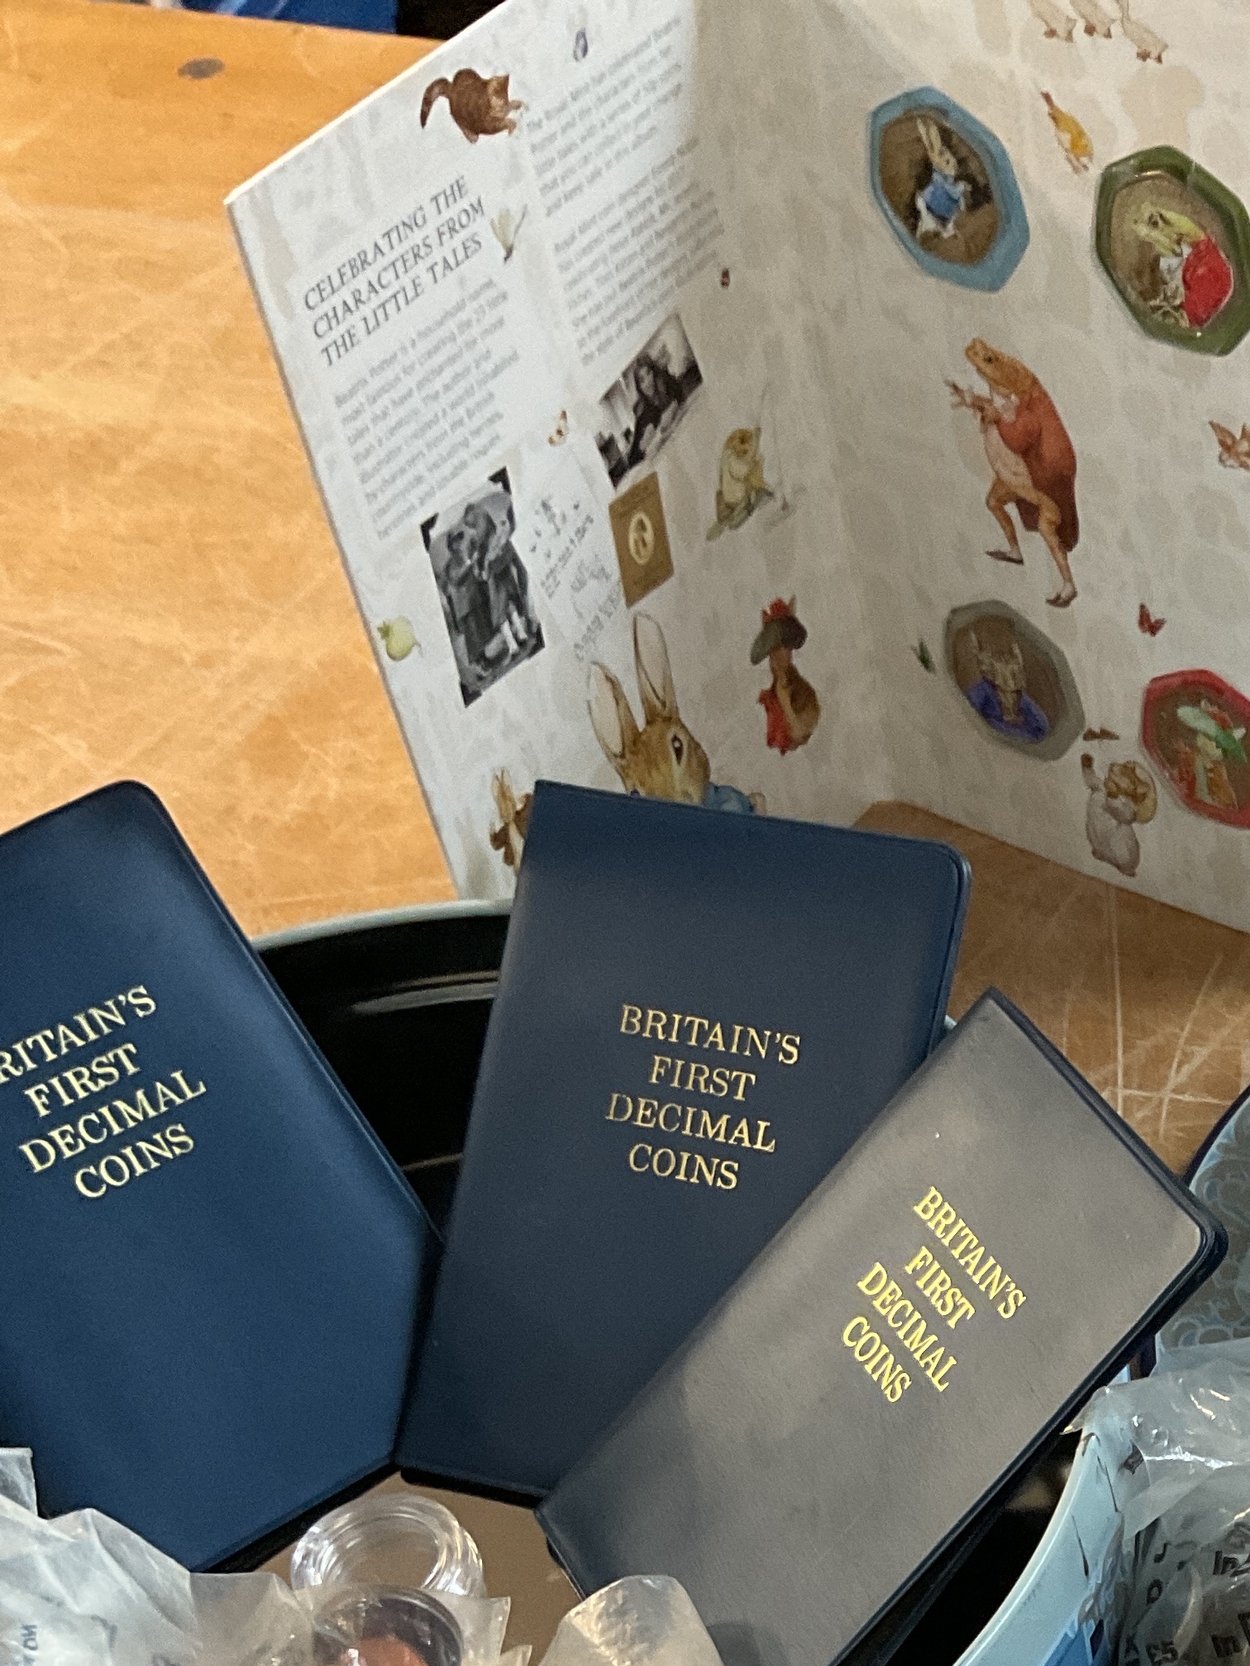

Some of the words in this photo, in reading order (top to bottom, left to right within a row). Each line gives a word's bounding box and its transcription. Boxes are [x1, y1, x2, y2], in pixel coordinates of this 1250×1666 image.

[304, 206, 428, 311] CELEBRATING
[430, 175, 470, 212] THE
[312, 234, 433, 339] CHARACTERS
[435, 198, 485, 251] FROM
[321, 325, 362, 368] THE
[361, 276, 425, 336] LITTLE
[426, 234, 483, 290] TALES
[0, 984, 157, 1084] RITAIN'S
[619, 1004, 801, 1065] BRITAIN'S
[648, 1055, 756, 1101] FIRST
[18, 1069, 207, 1174] DECIMAL
[23, 1043, 140, 1118] FIRST
[605, 1091, 776, 1153] DECIMAL
[74, 1122, 195, 1199] COINS
[628, 1143, 739, 1190] COINS
[903, 1245, 976, 1329] FIRST
[913, 1186, 1028, 1320] BRITAIN'S
[842, 1315, 912, 1403] COINS
[856, 1261, 957, 1392] DECIMAL
